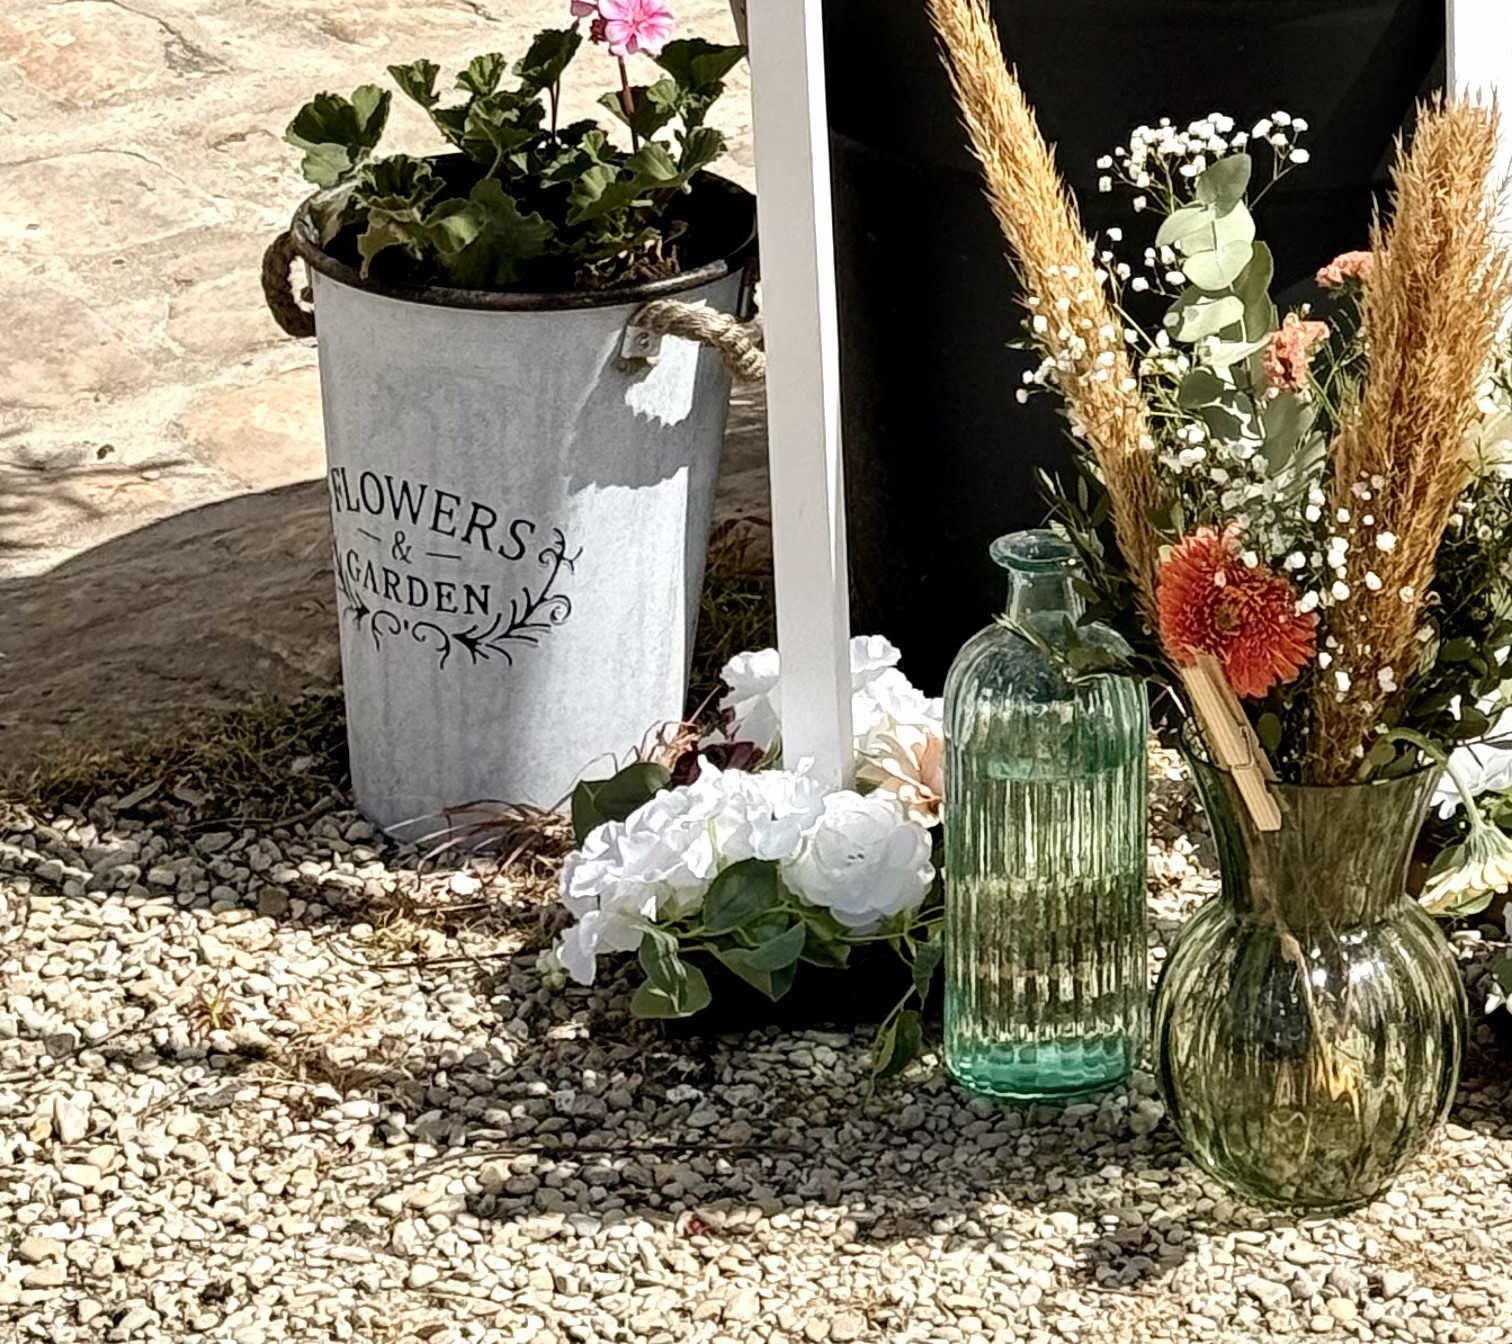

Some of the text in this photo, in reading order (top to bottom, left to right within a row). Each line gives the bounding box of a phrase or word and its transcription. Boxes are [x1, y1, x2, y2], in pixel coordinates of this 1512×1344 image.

[330, 466, 536, 561] FLOWERS
[391, 530, 412, 564] &
[346, 548, 491, 616] GARDEN
